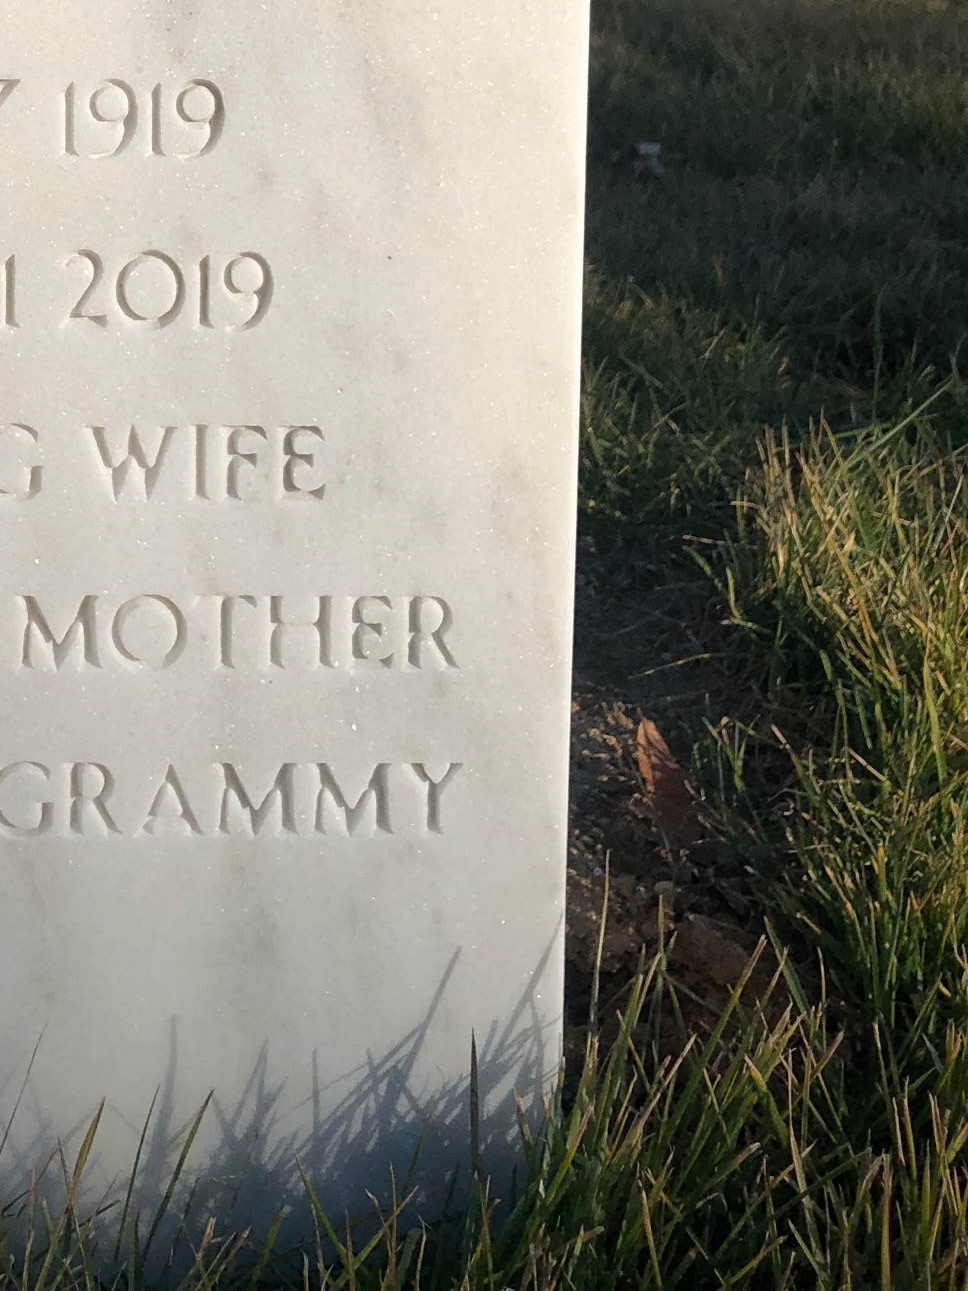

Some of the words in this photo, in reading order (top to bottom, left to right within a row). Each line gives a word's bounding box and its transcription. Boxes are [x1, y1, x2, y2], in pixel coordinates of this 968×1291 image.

[62, 77, 226, 158] 1919
[64, 248, 274, 332] 2019
[83, 424, 326, 503] WIFE
[14, 593, 460, 670] MOTHER
